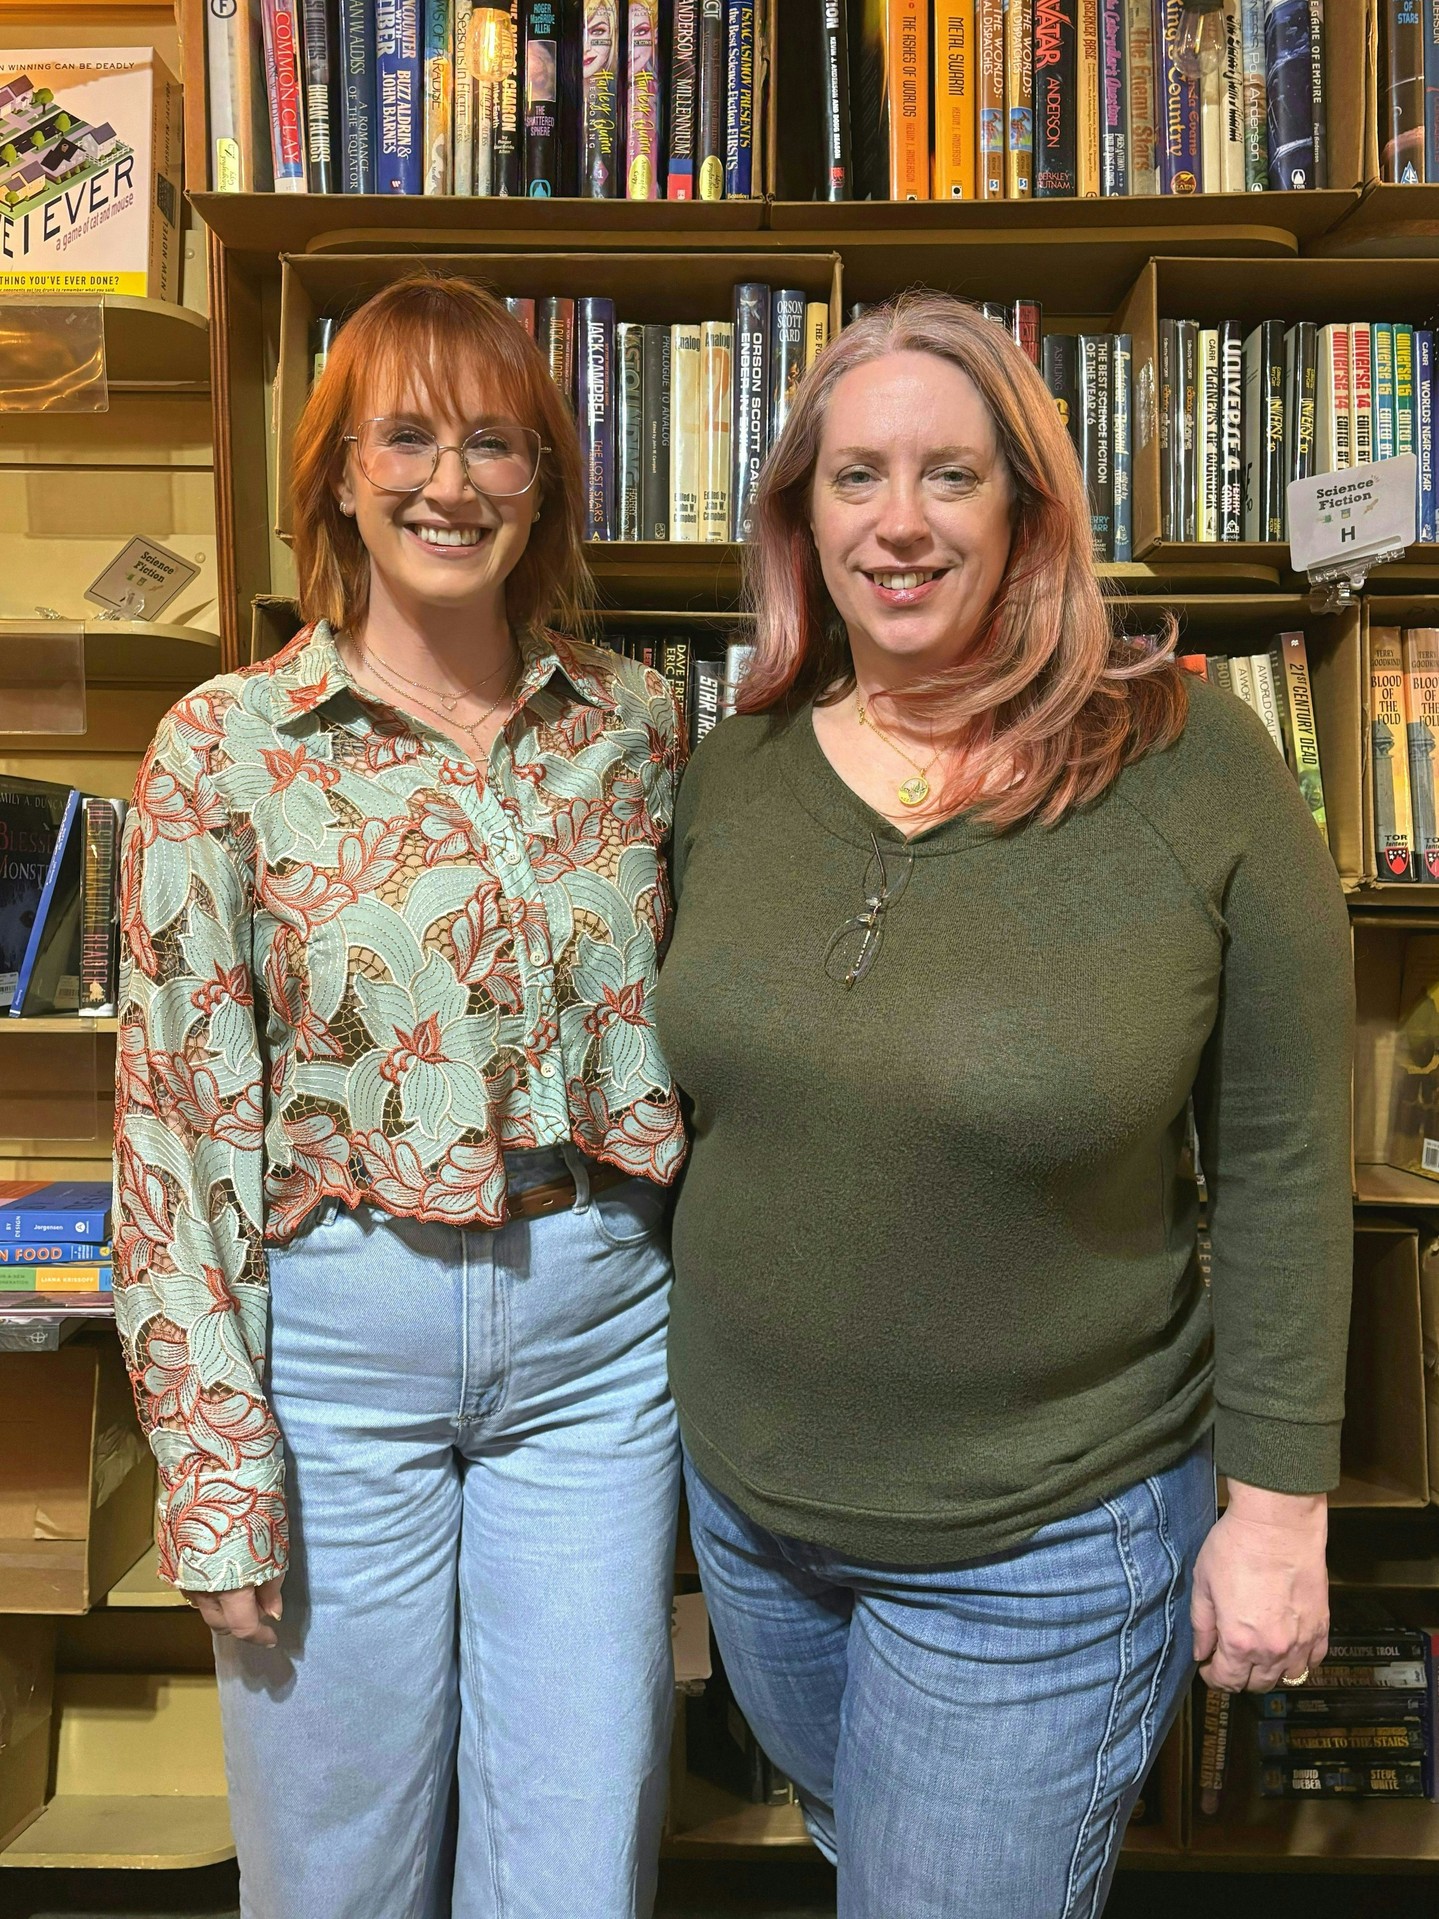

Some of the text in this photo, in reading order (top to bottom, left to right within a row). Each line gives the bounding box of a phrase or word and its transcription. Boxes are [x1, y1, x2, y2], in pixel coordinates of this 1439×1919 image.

[533, 3, 552, 14] ROGER
[1397, 13, 1419, 24] STARS
[1403, 2, 1413, 12] OF
[534, 24, 550, 34] ALLEN
[983, 17, 993, 75] DISPATCHES
[1130, 27, 1150, 59] The
[8, 63, 52, 71] WINNING
[79, 62, 92, 70] BE
[95, 62, 136, 70] DEADLY
[350, 37, 366, 75] ALDISS
[903, 16, 917, 118] THE ASHES OF WORLDS
[948, 16, 965, 96] METAL SWARM
[993, 8, 1003, 98] THE WORLDS:
[1022, 8, 1032, 98] THE WORLDS:
[1310, 10, 1322, 104] GAME EMPIRE
[275, 12, 299, 164] COMMON CLAY
[431, 47, 445, 110] PARADISE
[674, 0, 694, 154] ANDERSON MILLENNIUM
[739, 7, 753, 148] ISAAC ASIMOV PRESENTS
[1131, 65, 1151, 121] Enemy
[382, 72, 396, 154] JOHN BARNES
[396, 69, 411, 146] BUZZ ALDRIN
[535, 105, 545, 115] THE
[594, 69, 615, 154] Harley Quinn
[633, 69, 655, 154] Harley Quinn
[726, 25, 739, 170] Best Science FIRSTS
[1046, 77, 1061, 148] ANDERSON
[1249, 52, 1261, 161] Poul Anderson
[308, 84, 331, 162] BRIAN ALDISS
[348, 85, 358, 189] OF THE EQUATOR
[525, 116, 555, 127] SHATTERED
[530, 126, 551, 136] SPHERE
[360, 115, 369, 172] ROMANCE
[1132, 125, 1153, 171] Stars
[1038, 171, 1071, 181] BERKLEY
[44, 155, 134, 242] EVER
[23, 213, 30, 256] I
[56, 192, 134, 251] a game of cat and mouse
[29, 276, 120, 286] YOU'VE EVER DONE?
[777, 300, 803, 314] ORSON
[777, 314, 803, 329] SCOTT
[779, 328, 800, 343] CARD
[815, 322, 823, 342] THE
[587, 321, 604, 426] JACK CAMPBELL
[740, 332, 750, 389] ENDER
[1086, 342, 1096, 409] OF THE YEAR
[661, 335, 671, 447] PROLOGUE TO ANALOG
[704, 348, 730, 433] 2
[751, 332, 763, 452] ORSON SCOTT
[1205, 338, 1217, 426] CARR PLANETS
[1097, 342, 1108, 484] THE BEST SCIENCE FICTION
[1334, 394, 1350, 464] 14 EDITED BY
[1356, 393, 1371, 447] 14 EDITED
[1378, 382, 1392, 440] 15 EDITED
[1398, 409, 1412, 441] EDITED
[1421, 341, 1432, 492] CARR WORLDS NEAR and FAR
[593, 439, 604, 523] THE LOST STARS
[1316, 478, 1374, 500] Science
[1318, 491, 1373, 511] Fiction
[1340, 525, 1356, 543] H
[133, 560, 165, 583] Fiction
[140, 551, 175, 575] Science
[665, 647, 676, 676] ERIC
[676, 644, 687, 677] DAVE
[1370, 658, 1401, 667] GOODKIND
[1375, 649, 1395, 657] TERRY
[1418, 650, 1437, 659] TERRY
[698, 675, 718, 711] STAR
[1259, 674, 1272, 710] WORLD
[1371, 675, 1402, 688] BLOOD
[1381, 687, 1394, 700] OF
[1424, 689, 1437, 701] OF
[1290, 664, 1318, 765] 21ST CENTURY DEAD
[1377, 713, 1401, 725] FOLD
[1379, 700, 1398, 713] THE
[87, 804, 114, 825] THE
[84, 829, 112, 928] SUPERNATURAL
[82, 934, 109, 984] READER
[6, 1222, 12, 1231] BY
[33, 1224, 64, 1232] Jorgensen
[15, 1246, 63, 1262] FOOD
[1329, 1645, 1400, 1657] APOCALYPSE TROLL
[1215, 1728, 1228, 1770] HONOR
[1293, 1736, 1410, 1748] MARCH TO THE STARS
[1292, 1779, 1321, 1790] WEBER
[1293, 1769, 1319, 1779] DAVID
[1370, 1769, 1397, 1780] STEVE
[1370, 1779, 1400, 1790] WHITE
